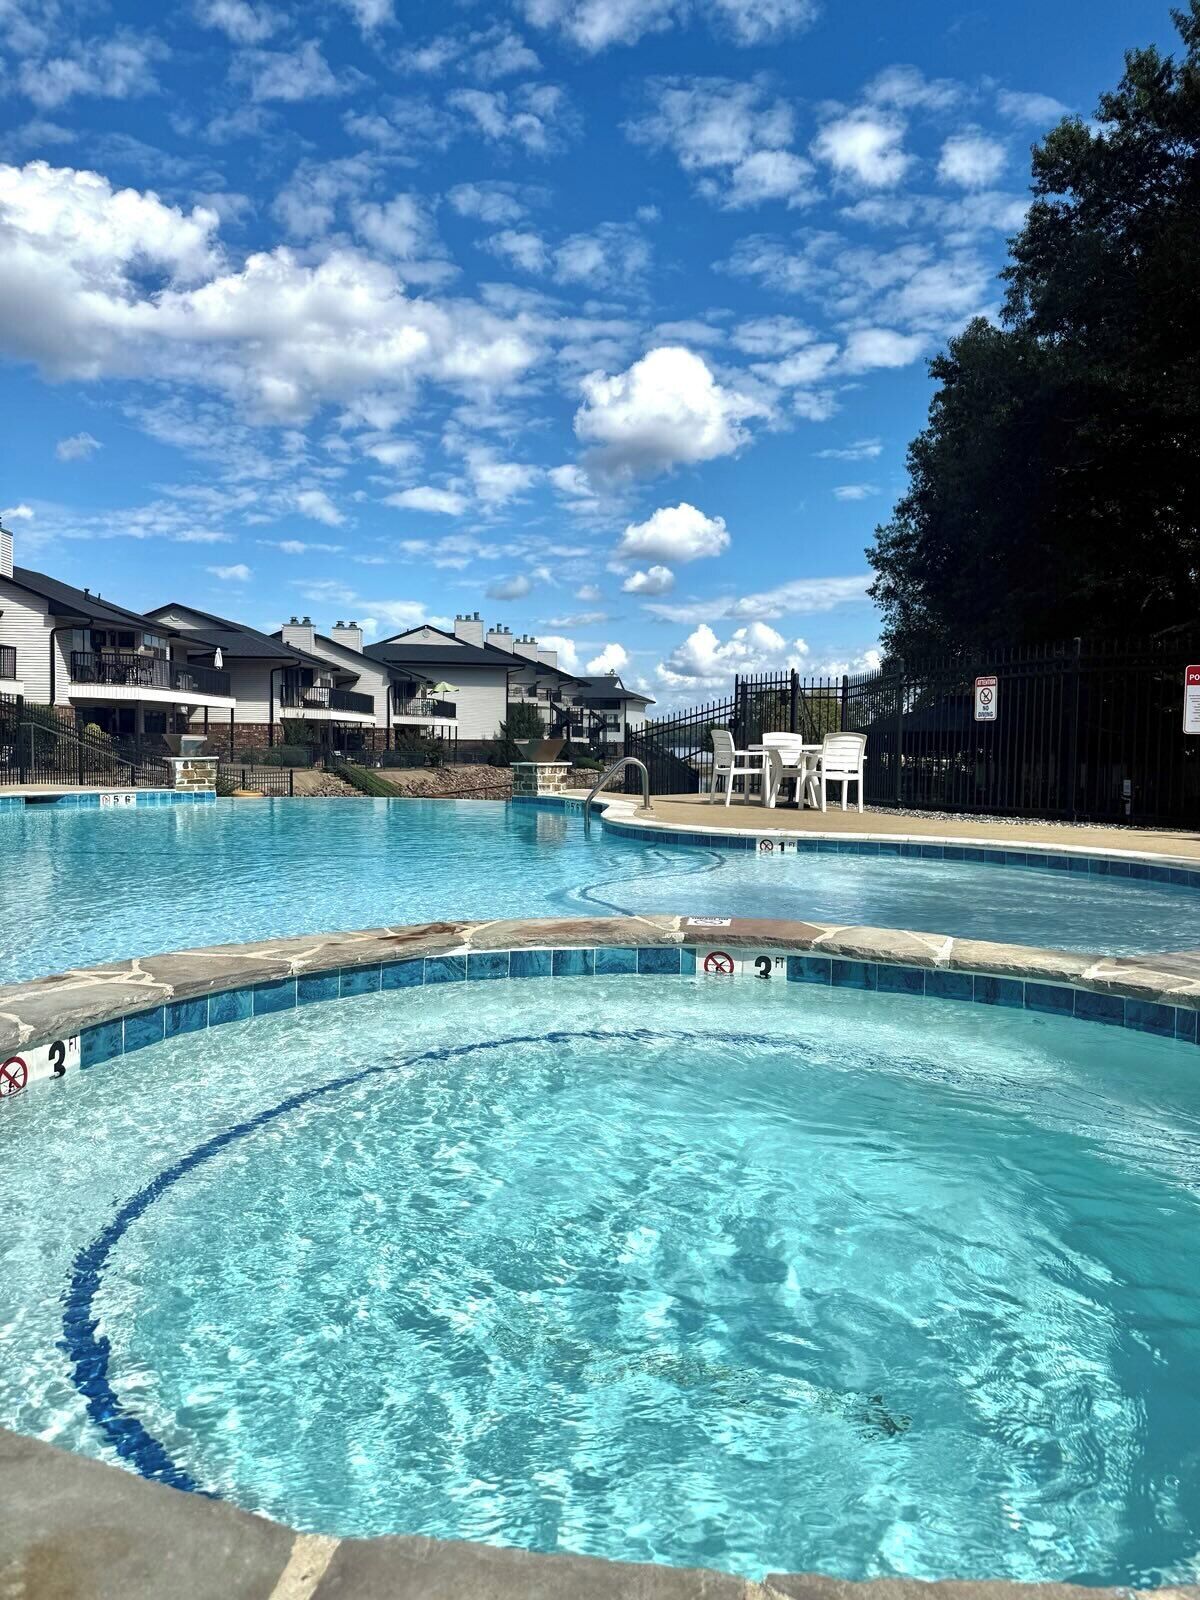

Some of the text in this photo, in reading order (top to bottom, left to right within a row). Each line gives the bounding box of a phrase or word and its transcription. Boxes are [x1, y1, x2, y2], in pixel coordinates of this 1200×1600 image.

[778, 841, 785, 851] 1
[754, 955, 784, 979] 3 FT
[48, 1034, 78, 1080] 3 FT
